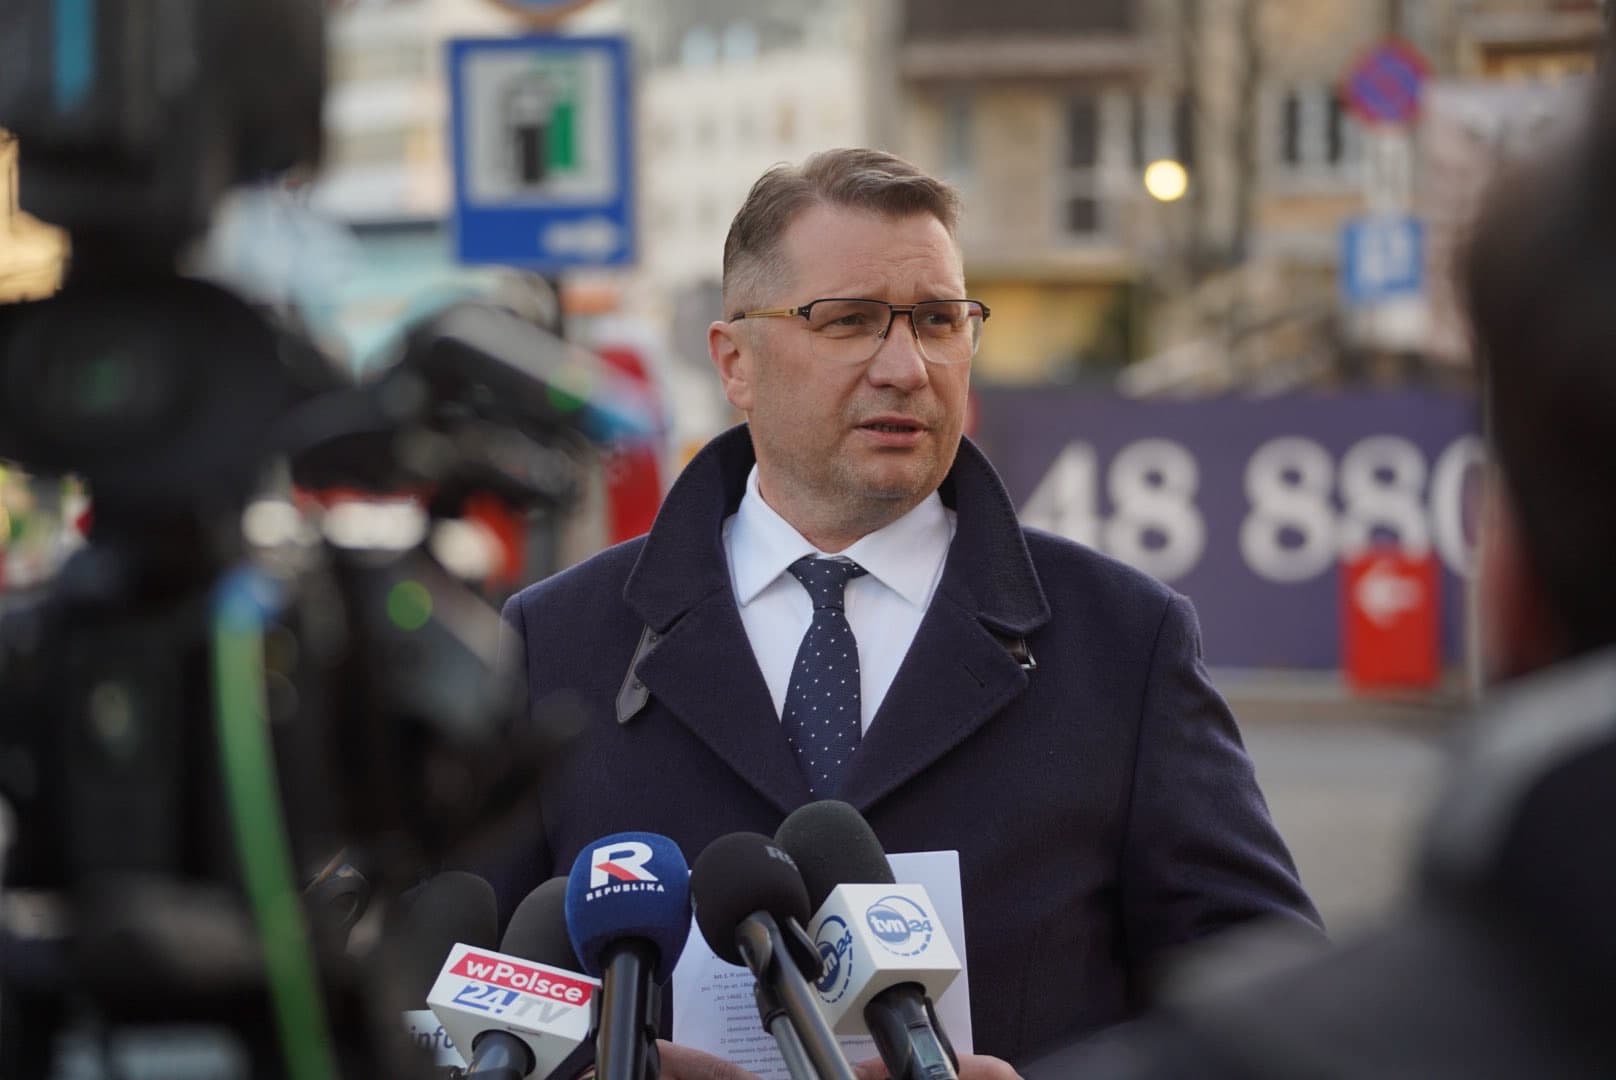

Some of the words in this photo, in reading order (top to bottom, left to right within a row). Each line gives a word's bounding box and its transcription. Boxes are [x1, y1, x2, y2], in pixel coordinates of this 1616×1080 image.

[1019, 438, 1205, 583] 48
[590, 842, 659, 889] R
[586, 883, 665, 902] REPUBLIKA
[466, 959, 583, 1002] wPolsce
